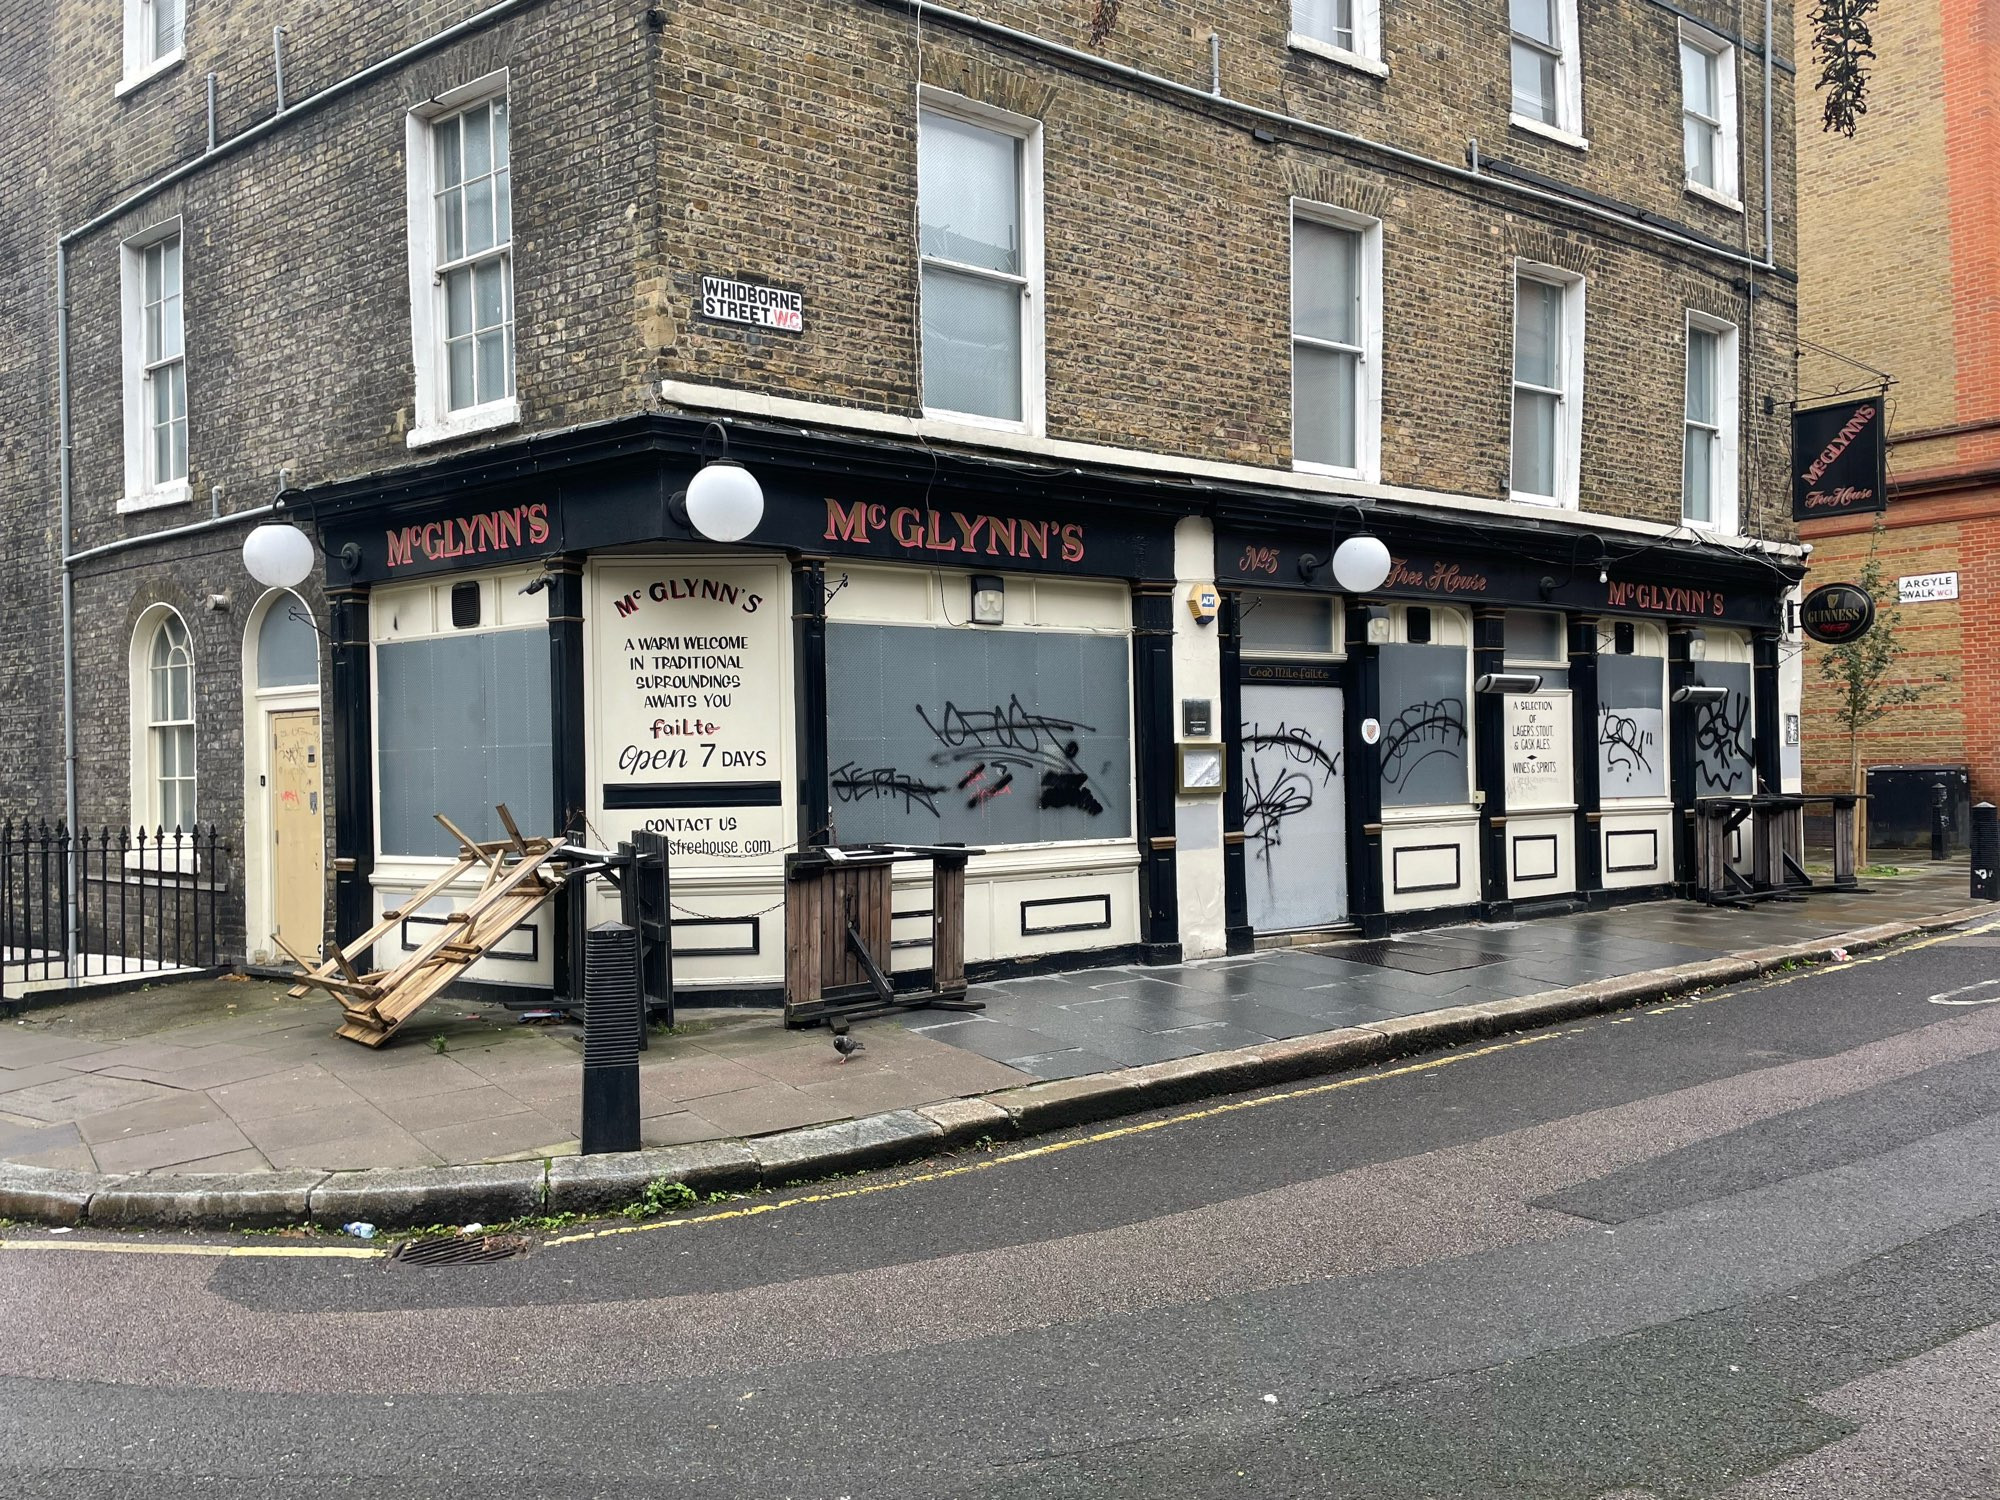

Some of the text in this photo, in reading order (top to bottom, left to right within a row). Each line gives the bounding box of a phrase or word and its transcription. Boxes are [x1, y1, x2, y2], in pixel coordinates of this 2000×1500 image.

[703, 278, 800, 311] WHIDBORNE
[1801, 404, 1876, 486] McGLYNN'S
[1828, 486, 1872, 505] House
[386, 503, 549, 567] McGLYNN'S
[823, 497, 1084, 562] McGLYNN'S
[1383, 556, 1487, 593] Free House
[1905, 576, 1952, 589] ARGYLE
[1202, 596, 1215, 605] ADT
[1608, 580, 1724, 615] McGLYNN'S
[1905, 589, 1935, 599] WALK
[1807, 608, 1860, 623] GUINNESS
[624, 636, 748, 651] A WARM WELCOME
[630, 655, 744, 670] IN TRADITIONAL
[636, 675, 741, 689] SURROUNDINGS
[644, 693, 732, 708] AWAITS YOU
[1513, 701, 1553, 710] A SELECTION
[1529, 714, 1537, 723] OF
[1514, 741, 1519, 750] &
[1521, 739, 1535, 750] CASK
[618, 743, 767, 776] Open 7 DAYS
[1512, 762, 1557, 774] WINES & SPIRITS
[645, 817, 737, 833] CONTACT US
